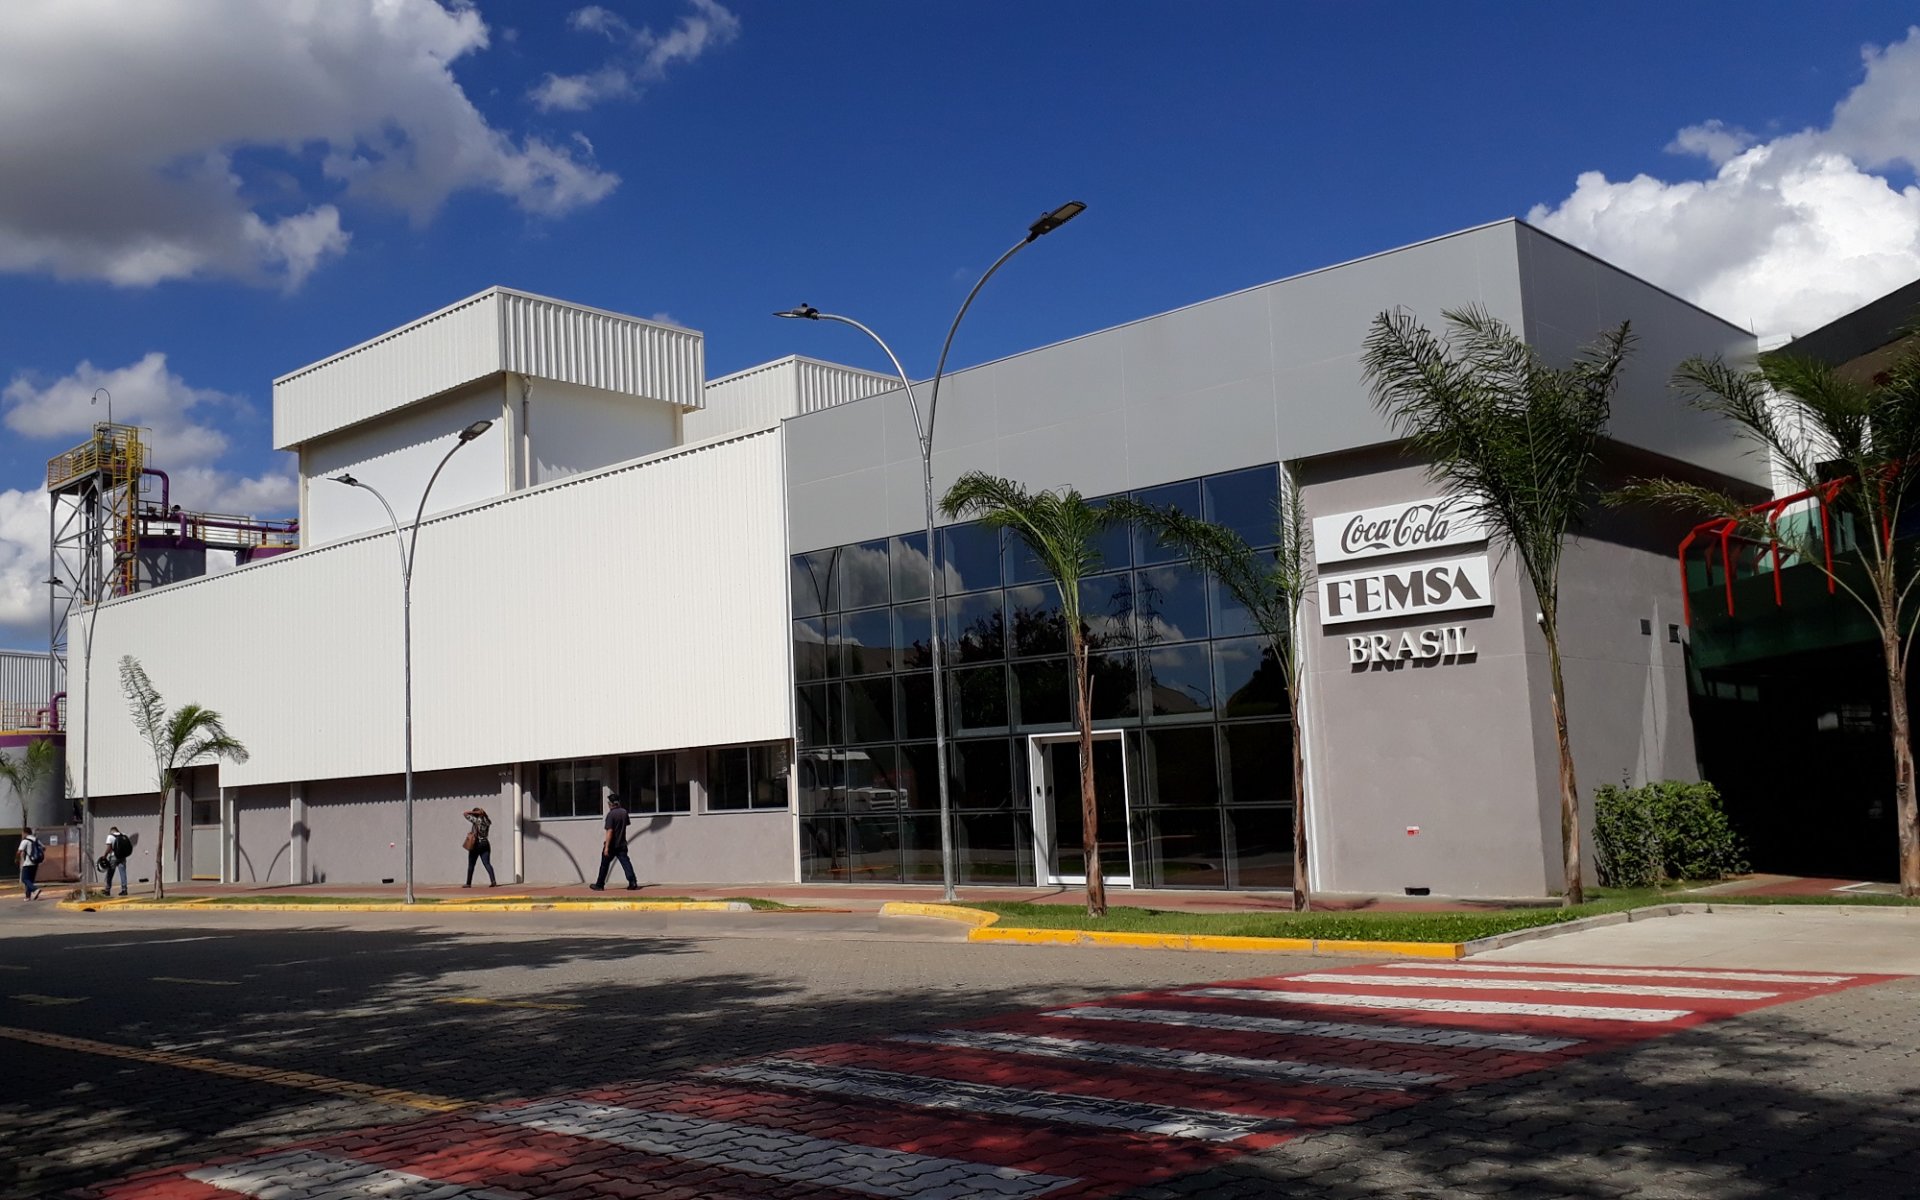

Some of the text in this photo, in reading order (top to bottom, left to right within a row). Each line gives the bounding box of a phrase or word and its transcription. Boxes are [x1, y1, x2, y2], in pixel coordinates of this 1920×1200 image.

[1341, 504, 1449, 554] Coca-Cola
[1327, 566, 1481, 617] FEMSA
[1347, 627, 1476, 664] BRASIL
